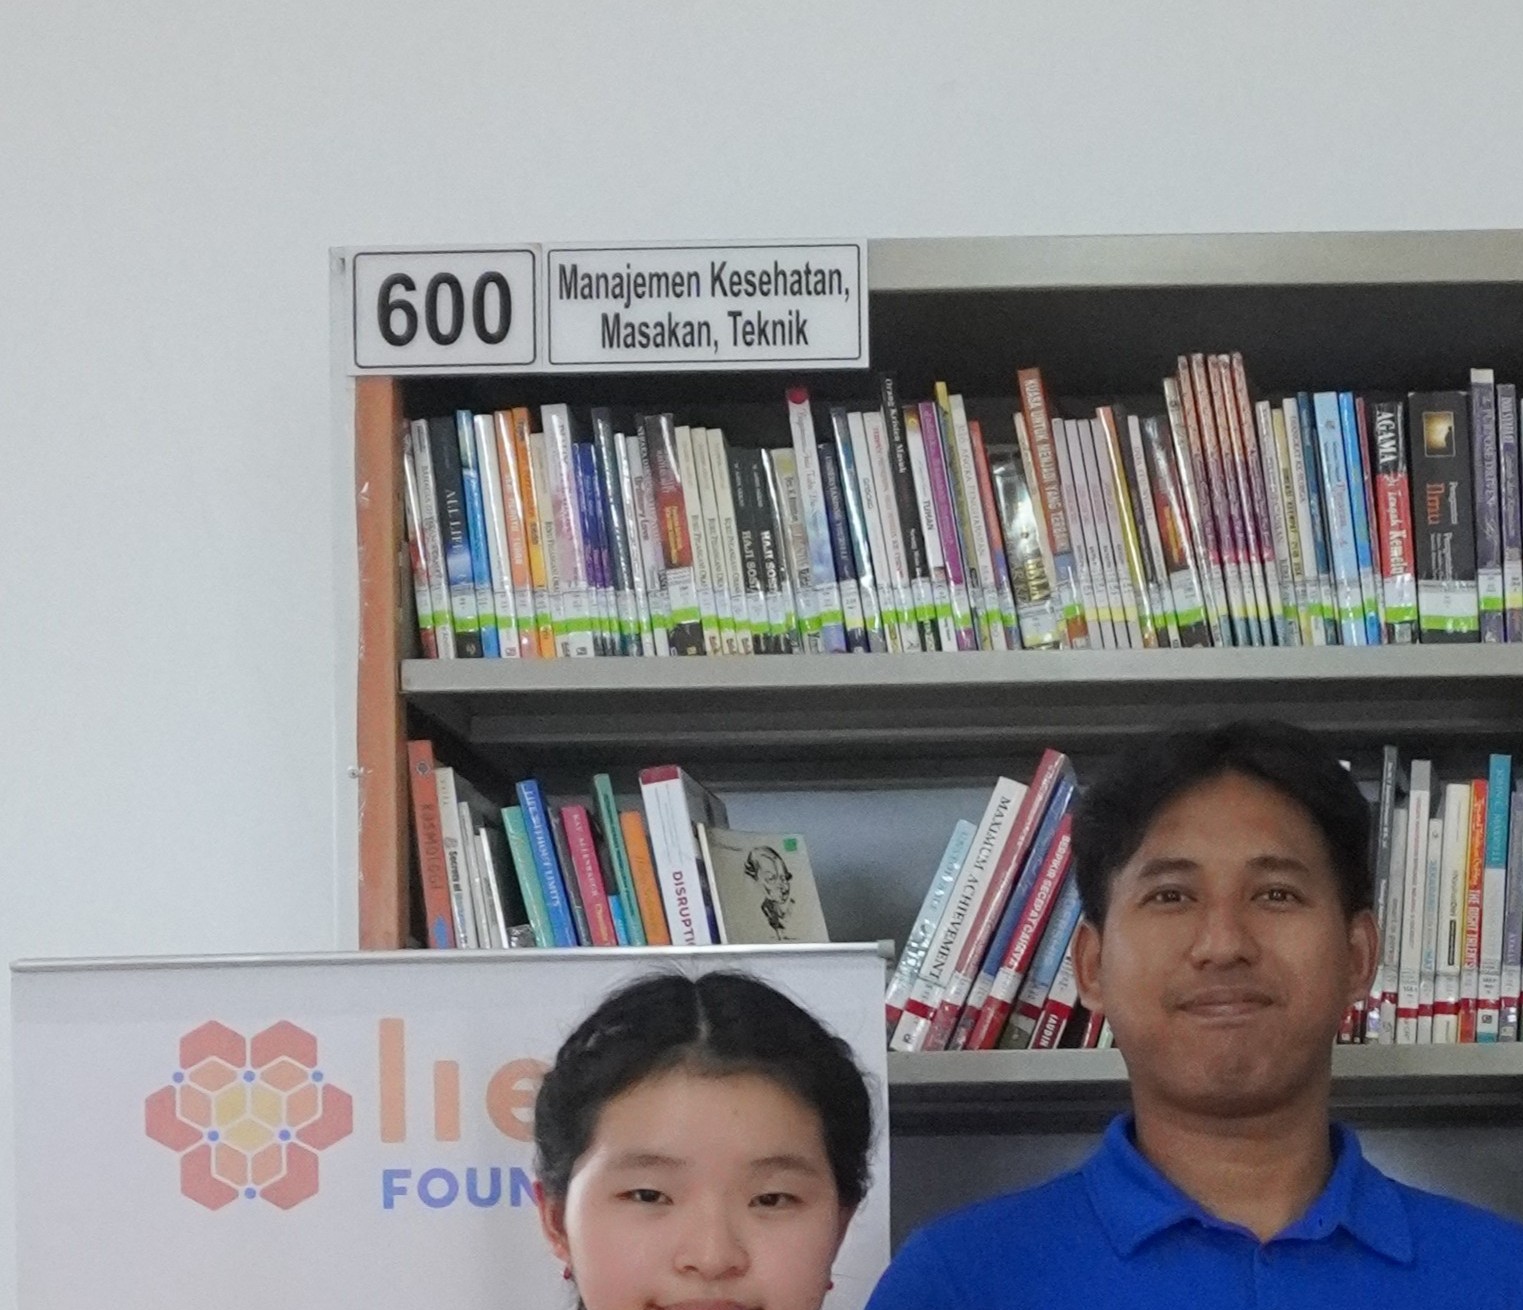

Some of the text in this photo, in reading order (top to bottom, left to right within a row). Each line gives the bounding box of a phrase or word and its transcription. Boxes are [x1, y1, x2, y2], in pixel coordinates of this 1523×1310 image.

[558, 260, 850, 308] Manajemen Kesehatan,
[378, 270, 513, 347] 600
[601, 309, 809, 354] Masakan, Teknik
[1024, 378, 1040, 410] KUASA
[884, 378, 907, 474] Orang Kristen Masuk
[1031, 410, 1047, 441] UNTUK
[1376, 411, 1398, 464] AGAMA
[1035, 444, 1055, 483] MENJADI
[1044, 485, 1061, 510] YANG
[1424, 482, 1445, 526] Ilmu
[741, 530, 753, 558] HAJI
[760, 530, 772, 558] HAJI
[573, 814, 583, 832] KAY
[421, 804, 442, 889] KOSMOLOGI
[1046, 835, 1071, 878] BERPIKIR
[448, 851, 462, 892] Secrets of
[544, 870, 560, 907] LIMITS
[928, 796, 1012, 983] MAXIMUM ACHIEVEMENT
[1025, 879, 1054, 925] SECEPAT
[1469, 889, 1481, 902] THE
[1465, 934, 1478, 968] TALENTS
